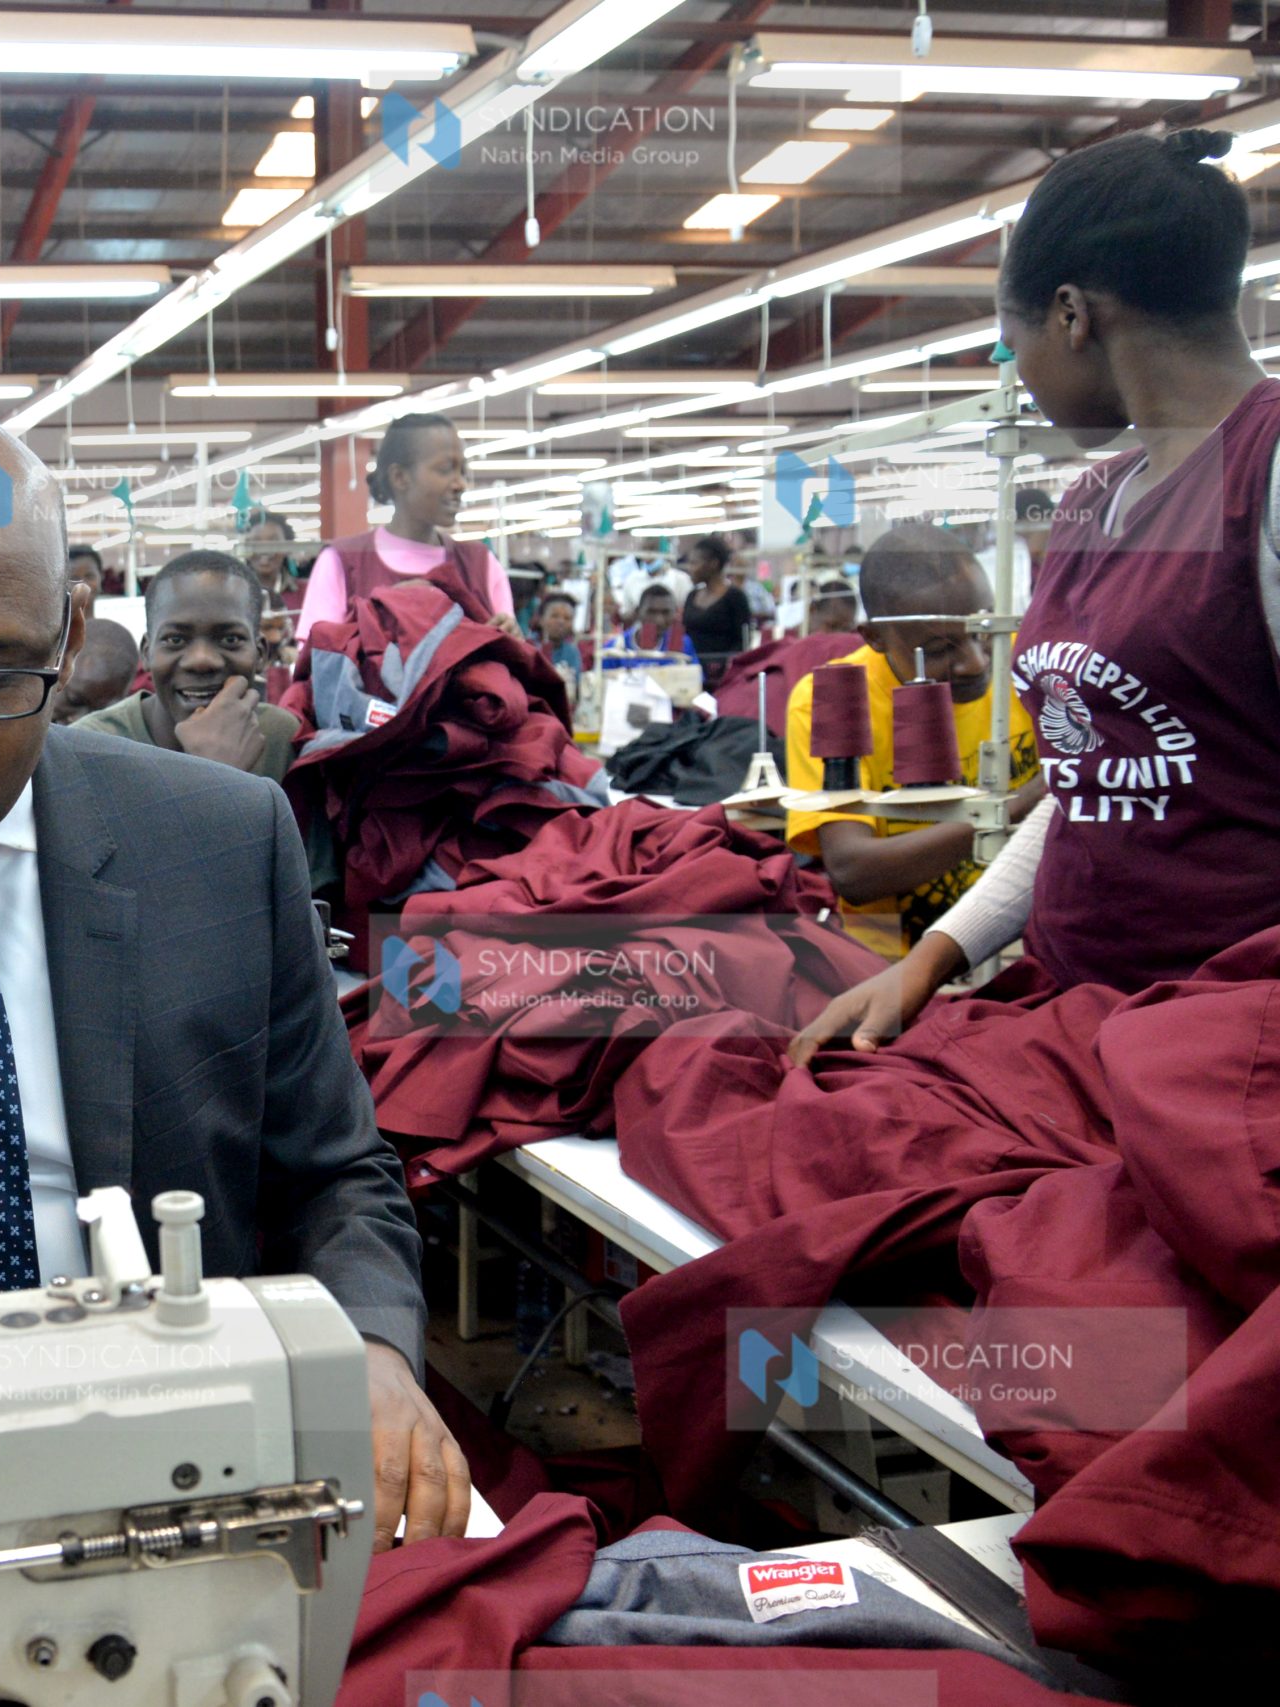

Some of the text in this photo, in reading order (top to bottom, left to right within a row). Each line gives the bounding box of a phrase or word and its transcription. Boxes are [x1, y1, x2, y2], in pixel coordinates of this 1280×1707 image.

[1017, 642, 1088, 682] SHAKTI
[1140, 704, 1196, 751] LTD
[1097, 754, 1197, 789] UNIT
[1056, 795, 1170, 822] LITY
[753, 1563, 837, 1582] Wrangler
[754, 1589, 846, 1612] Premium Quality
